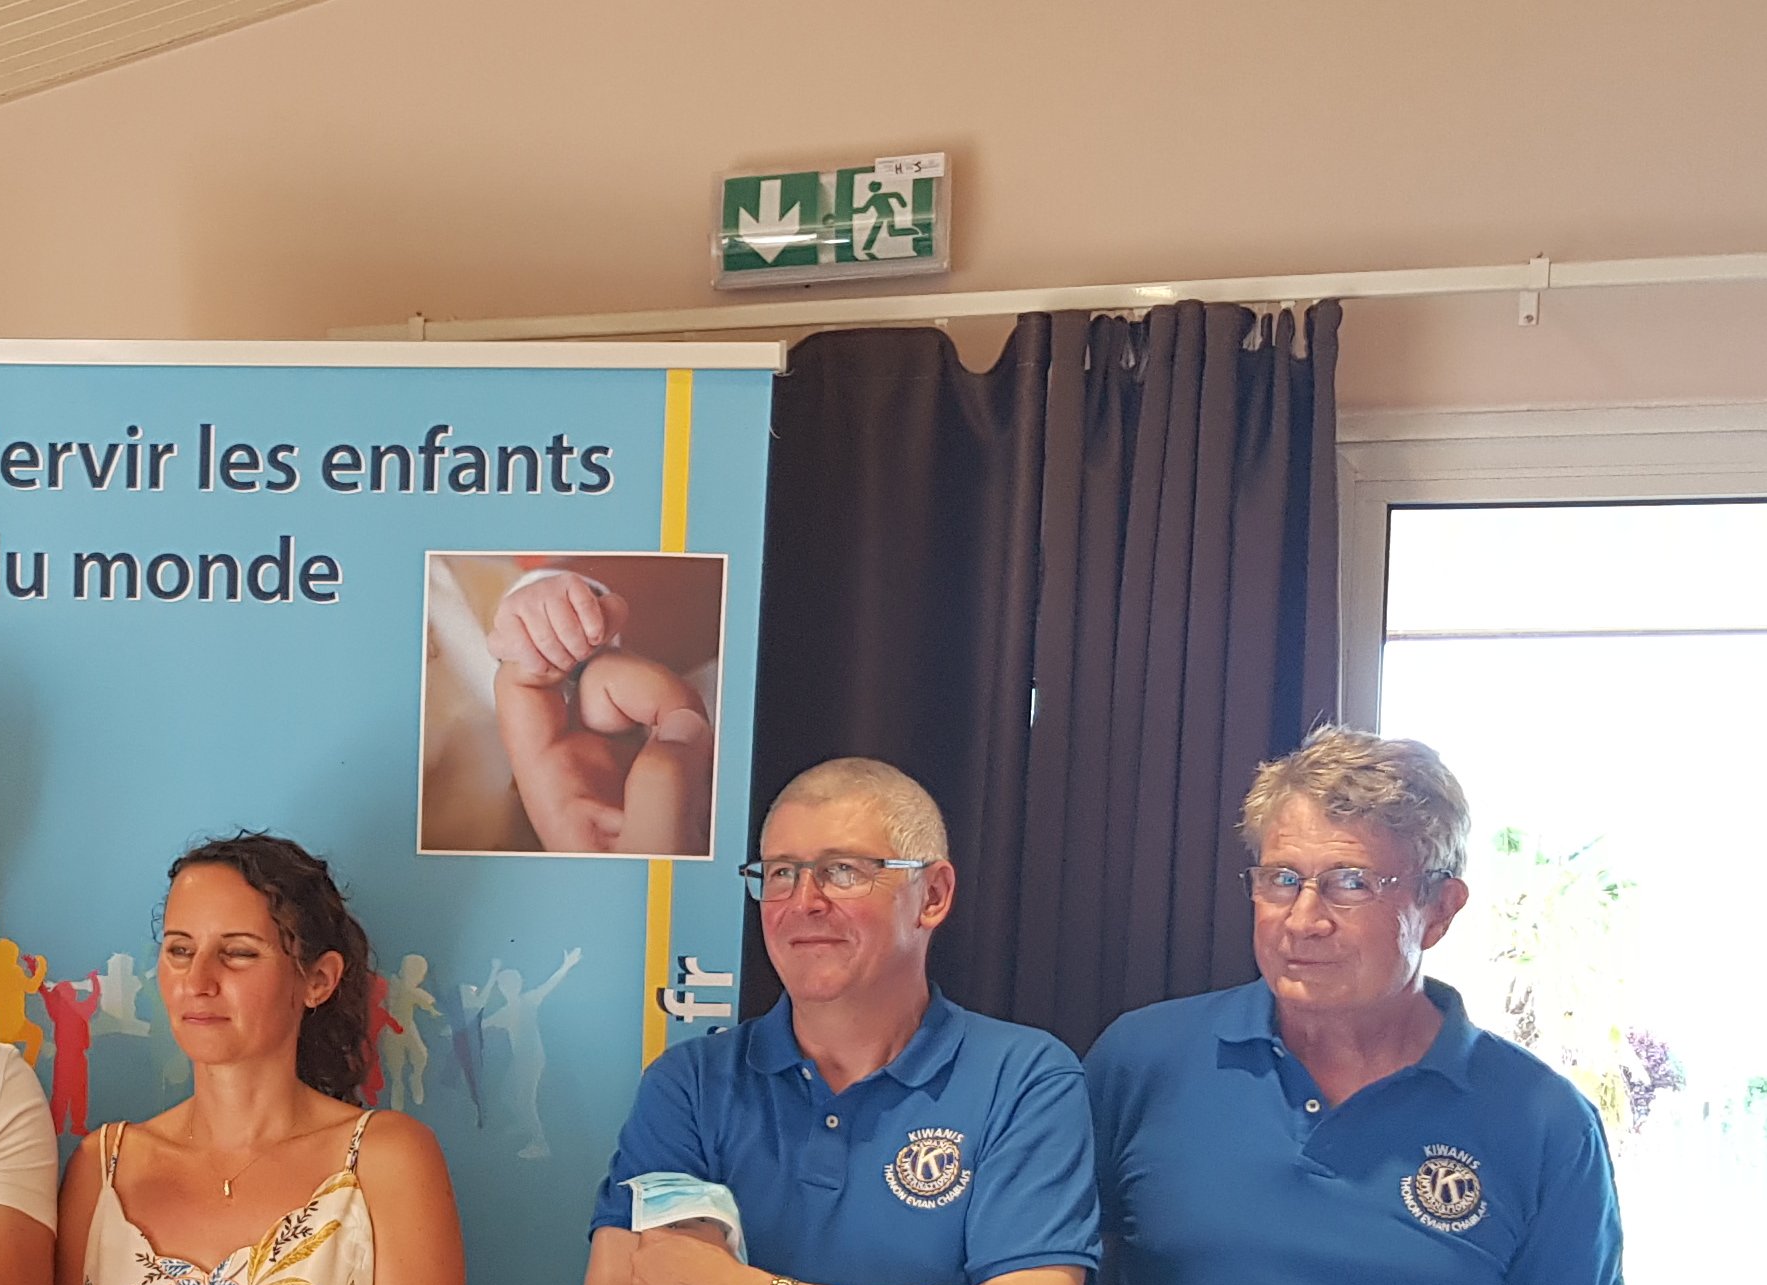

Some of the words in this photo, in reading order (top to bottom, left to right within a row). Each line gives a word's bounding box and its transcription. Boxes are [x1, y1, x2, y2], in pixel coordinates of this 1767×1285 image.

[199, 423, 301, 496] les
[321, 423, 615, 496] enfants
[73, 535, 343, 606] monde
[907, 1127, 964, 1144] KIWANIS
[915, 1146, 945, 1181] K
[1423, 1143, 1482, 1170] KIWANIS
[884, 1163, 908, 1201] THONON
[906, 1196, 936, 1209] EVIAN
[937, 1169, 971, 1206] CHABLAIS
[1400, 1175, 1423, 1218] THONON
[1434, 1166, 1462, 1203] K
